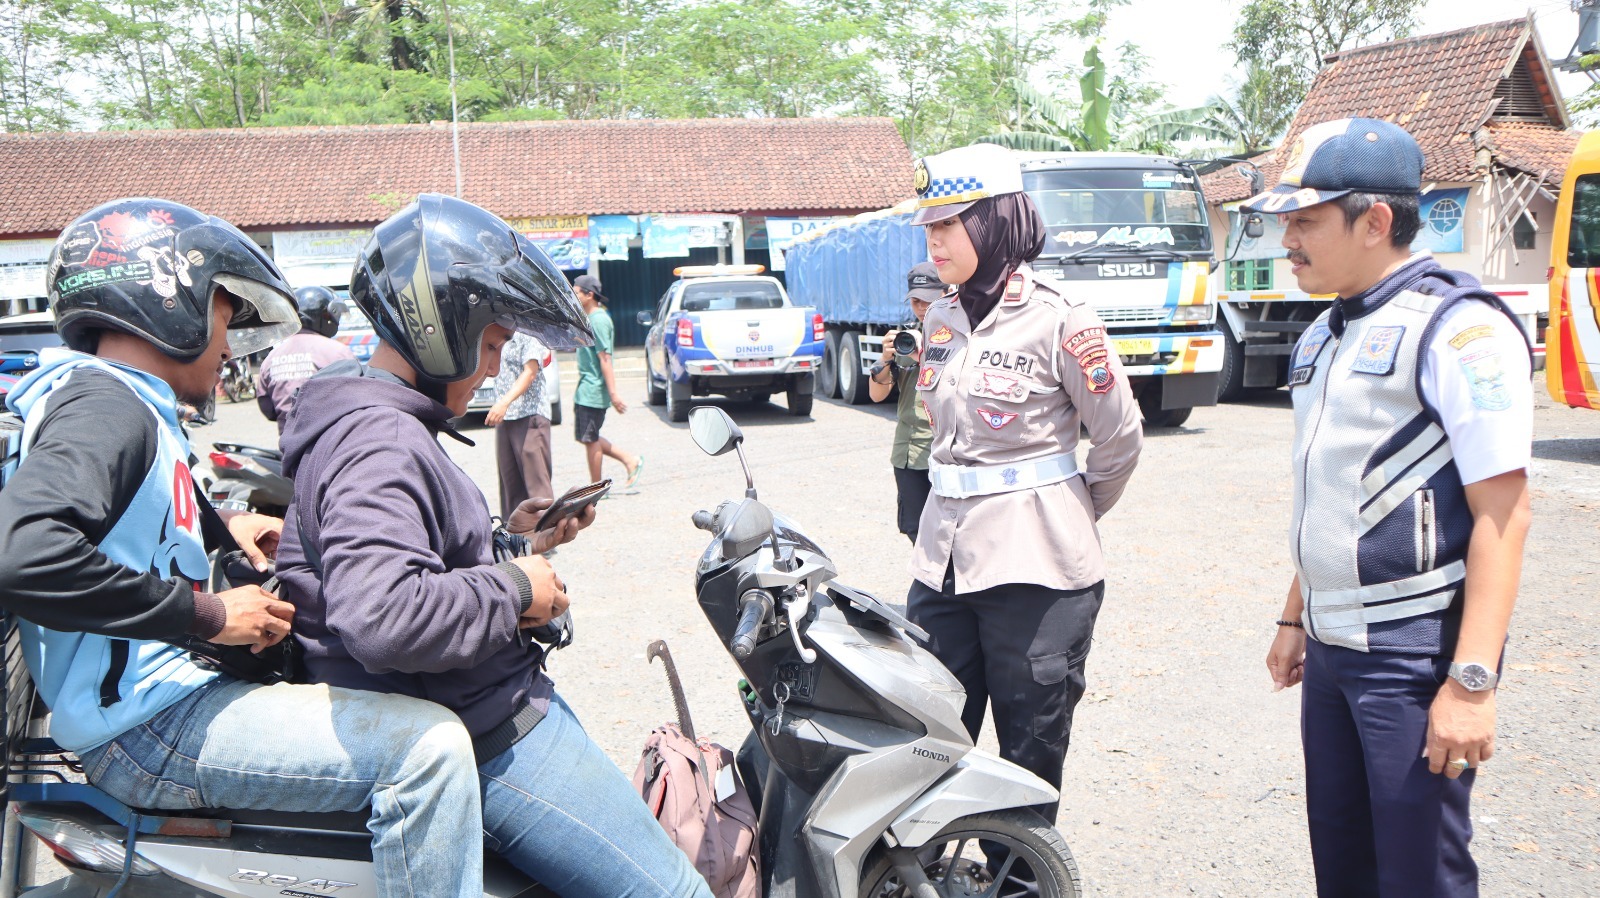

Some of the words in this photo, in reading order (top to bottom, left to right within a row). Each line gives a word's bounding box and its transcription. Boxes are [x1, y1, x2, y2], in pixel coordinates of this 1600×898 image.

[529, 218, 558, 230] SINAR
[560, 217, 584, 229] JAYA
[1097, 263, 1156, 277] ISUZU
[735, 344, 774, 354] DINHUB
[978, 350, 1034, 375] POLRI
[912, 746, 950, 763] HONDA
